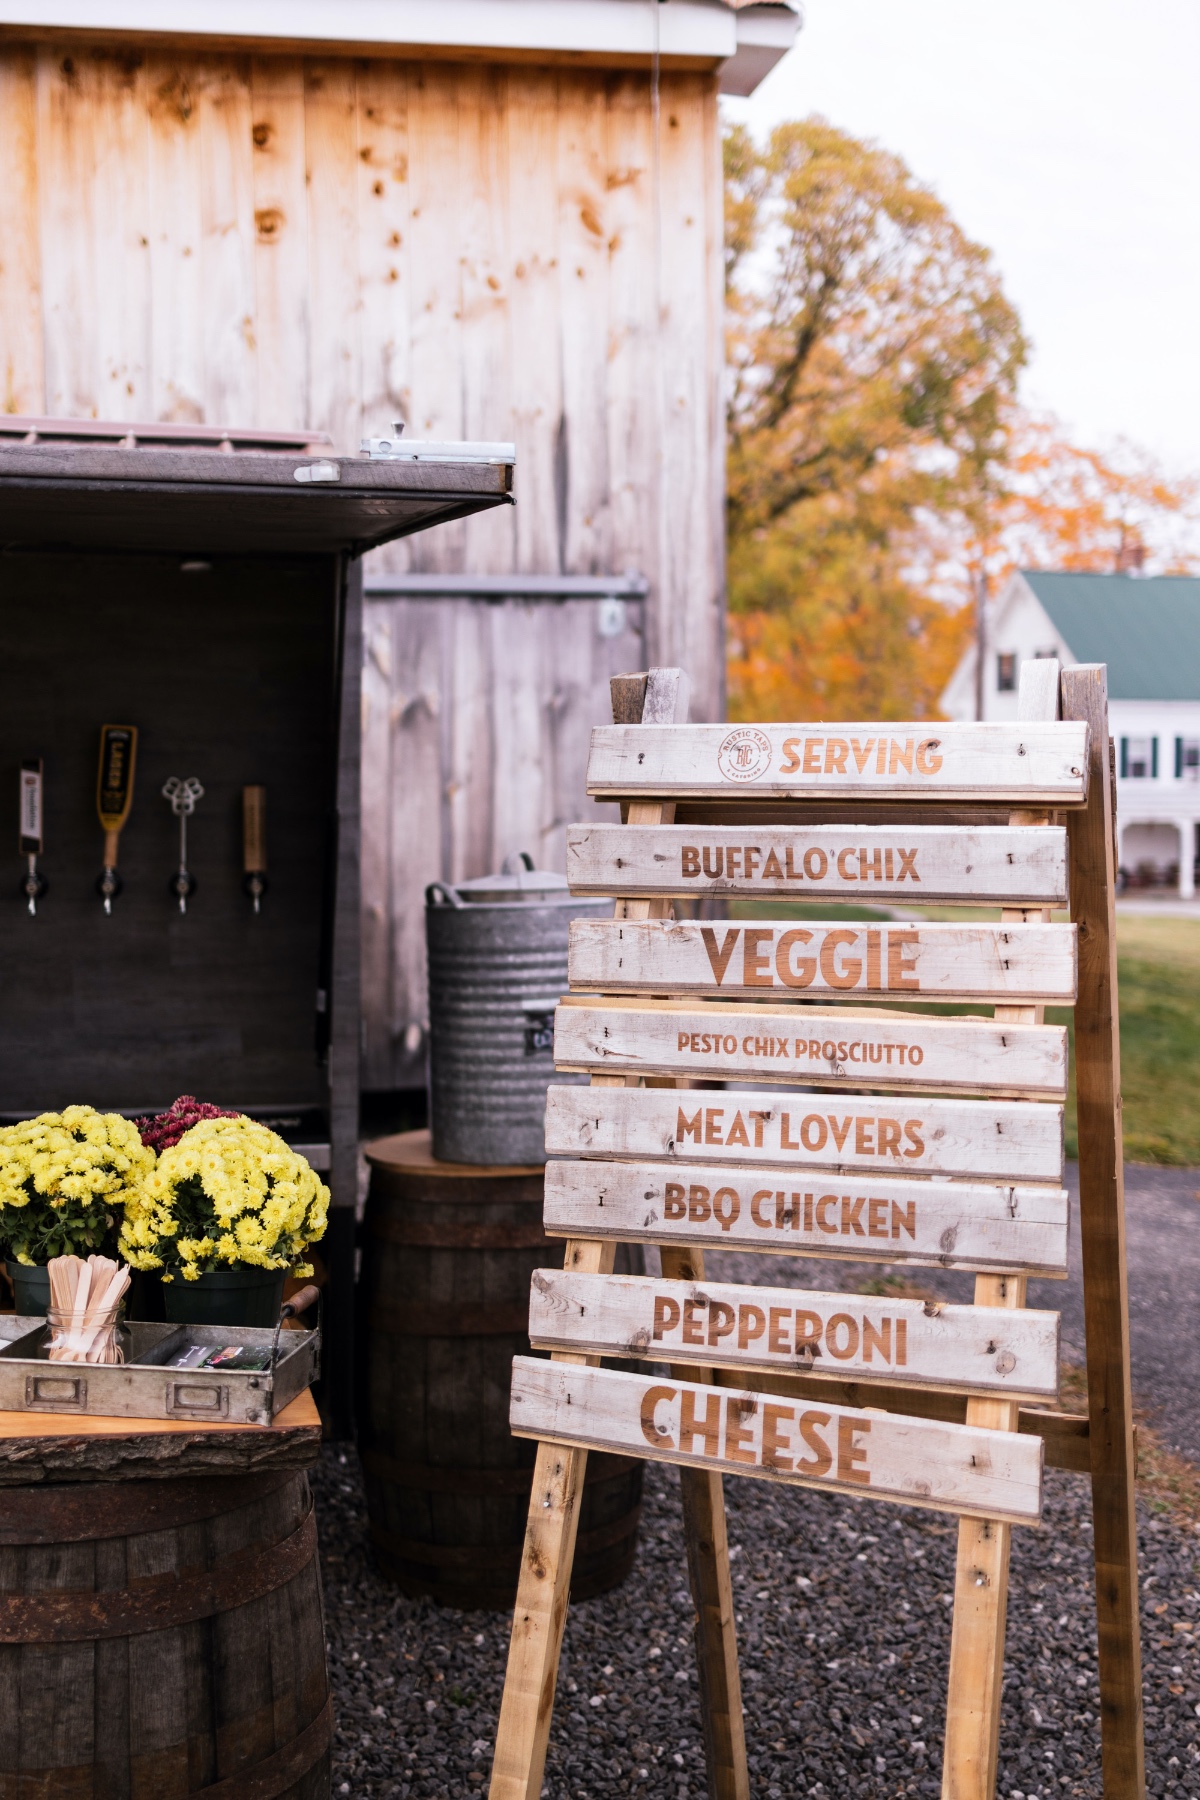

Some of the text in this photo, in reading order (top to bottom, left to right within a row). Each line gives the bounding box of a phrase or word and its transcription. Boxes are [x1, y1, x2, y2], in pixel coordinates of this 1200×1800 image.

[723, 731, 769, 751] RUSTIC TAPS
[779, 738, 943, 775] SERVING
[681, 846, 921, 882] BUFFALO CHIX
[700, 928, 921, 992] VEGGIE
[677, 1032, 924, 1066] PESTO CHIX PROSCIUTTO
[676, 1106, 925, 1159] MEAT LOVERS
[663, 1183, 917, 1240] BBQ CHICKEN
[653, 1296, 907, 1366] PEPPERONI
[640, 1386, 871, 1484] CHEESE
